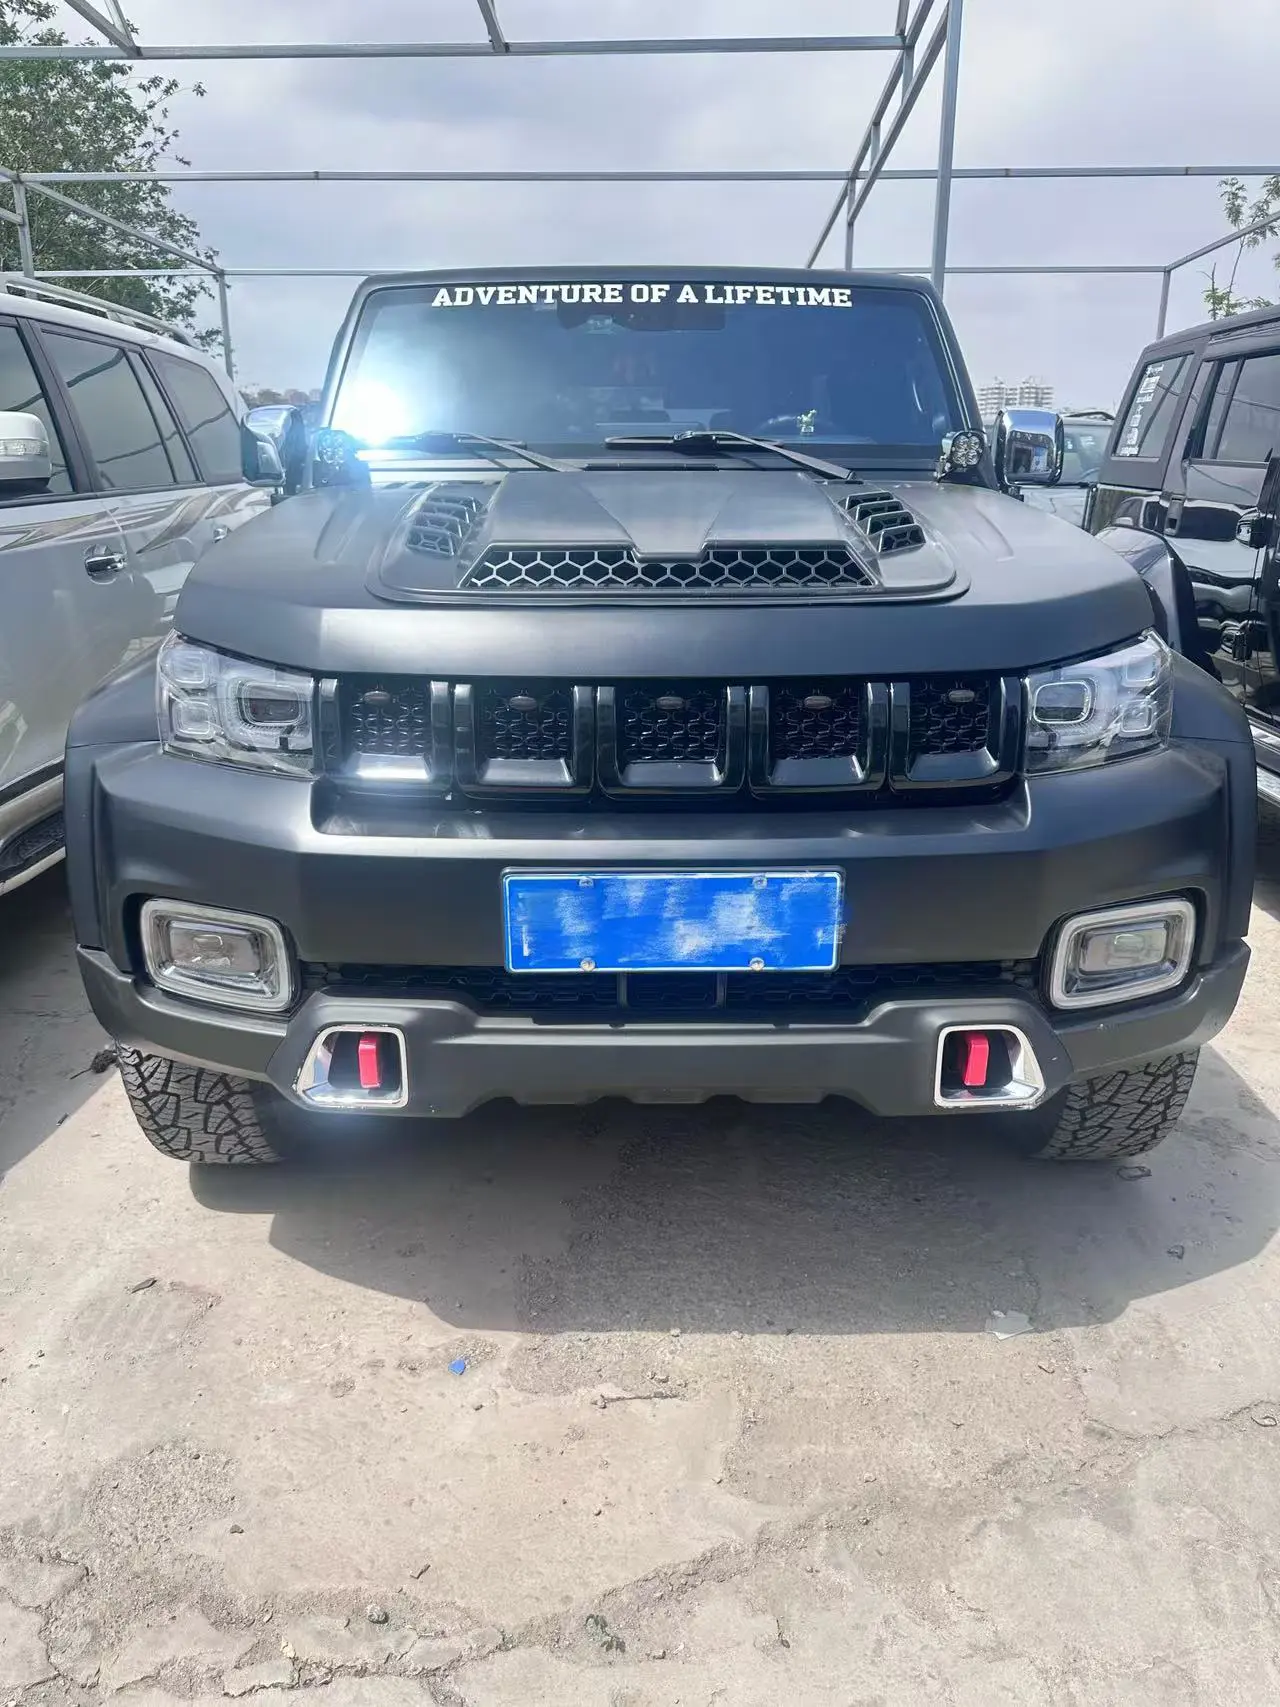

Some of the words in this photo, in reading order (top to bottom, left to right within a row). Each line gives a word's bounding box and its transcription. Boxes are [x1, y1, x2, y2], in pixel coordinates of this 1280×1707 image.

[432, 285, 623, 307] ADVENTURE
[630, 284, 670, 304] OF
[676, 284, 699, 304] A
[705, 285, 853, 307] LIFETIME
